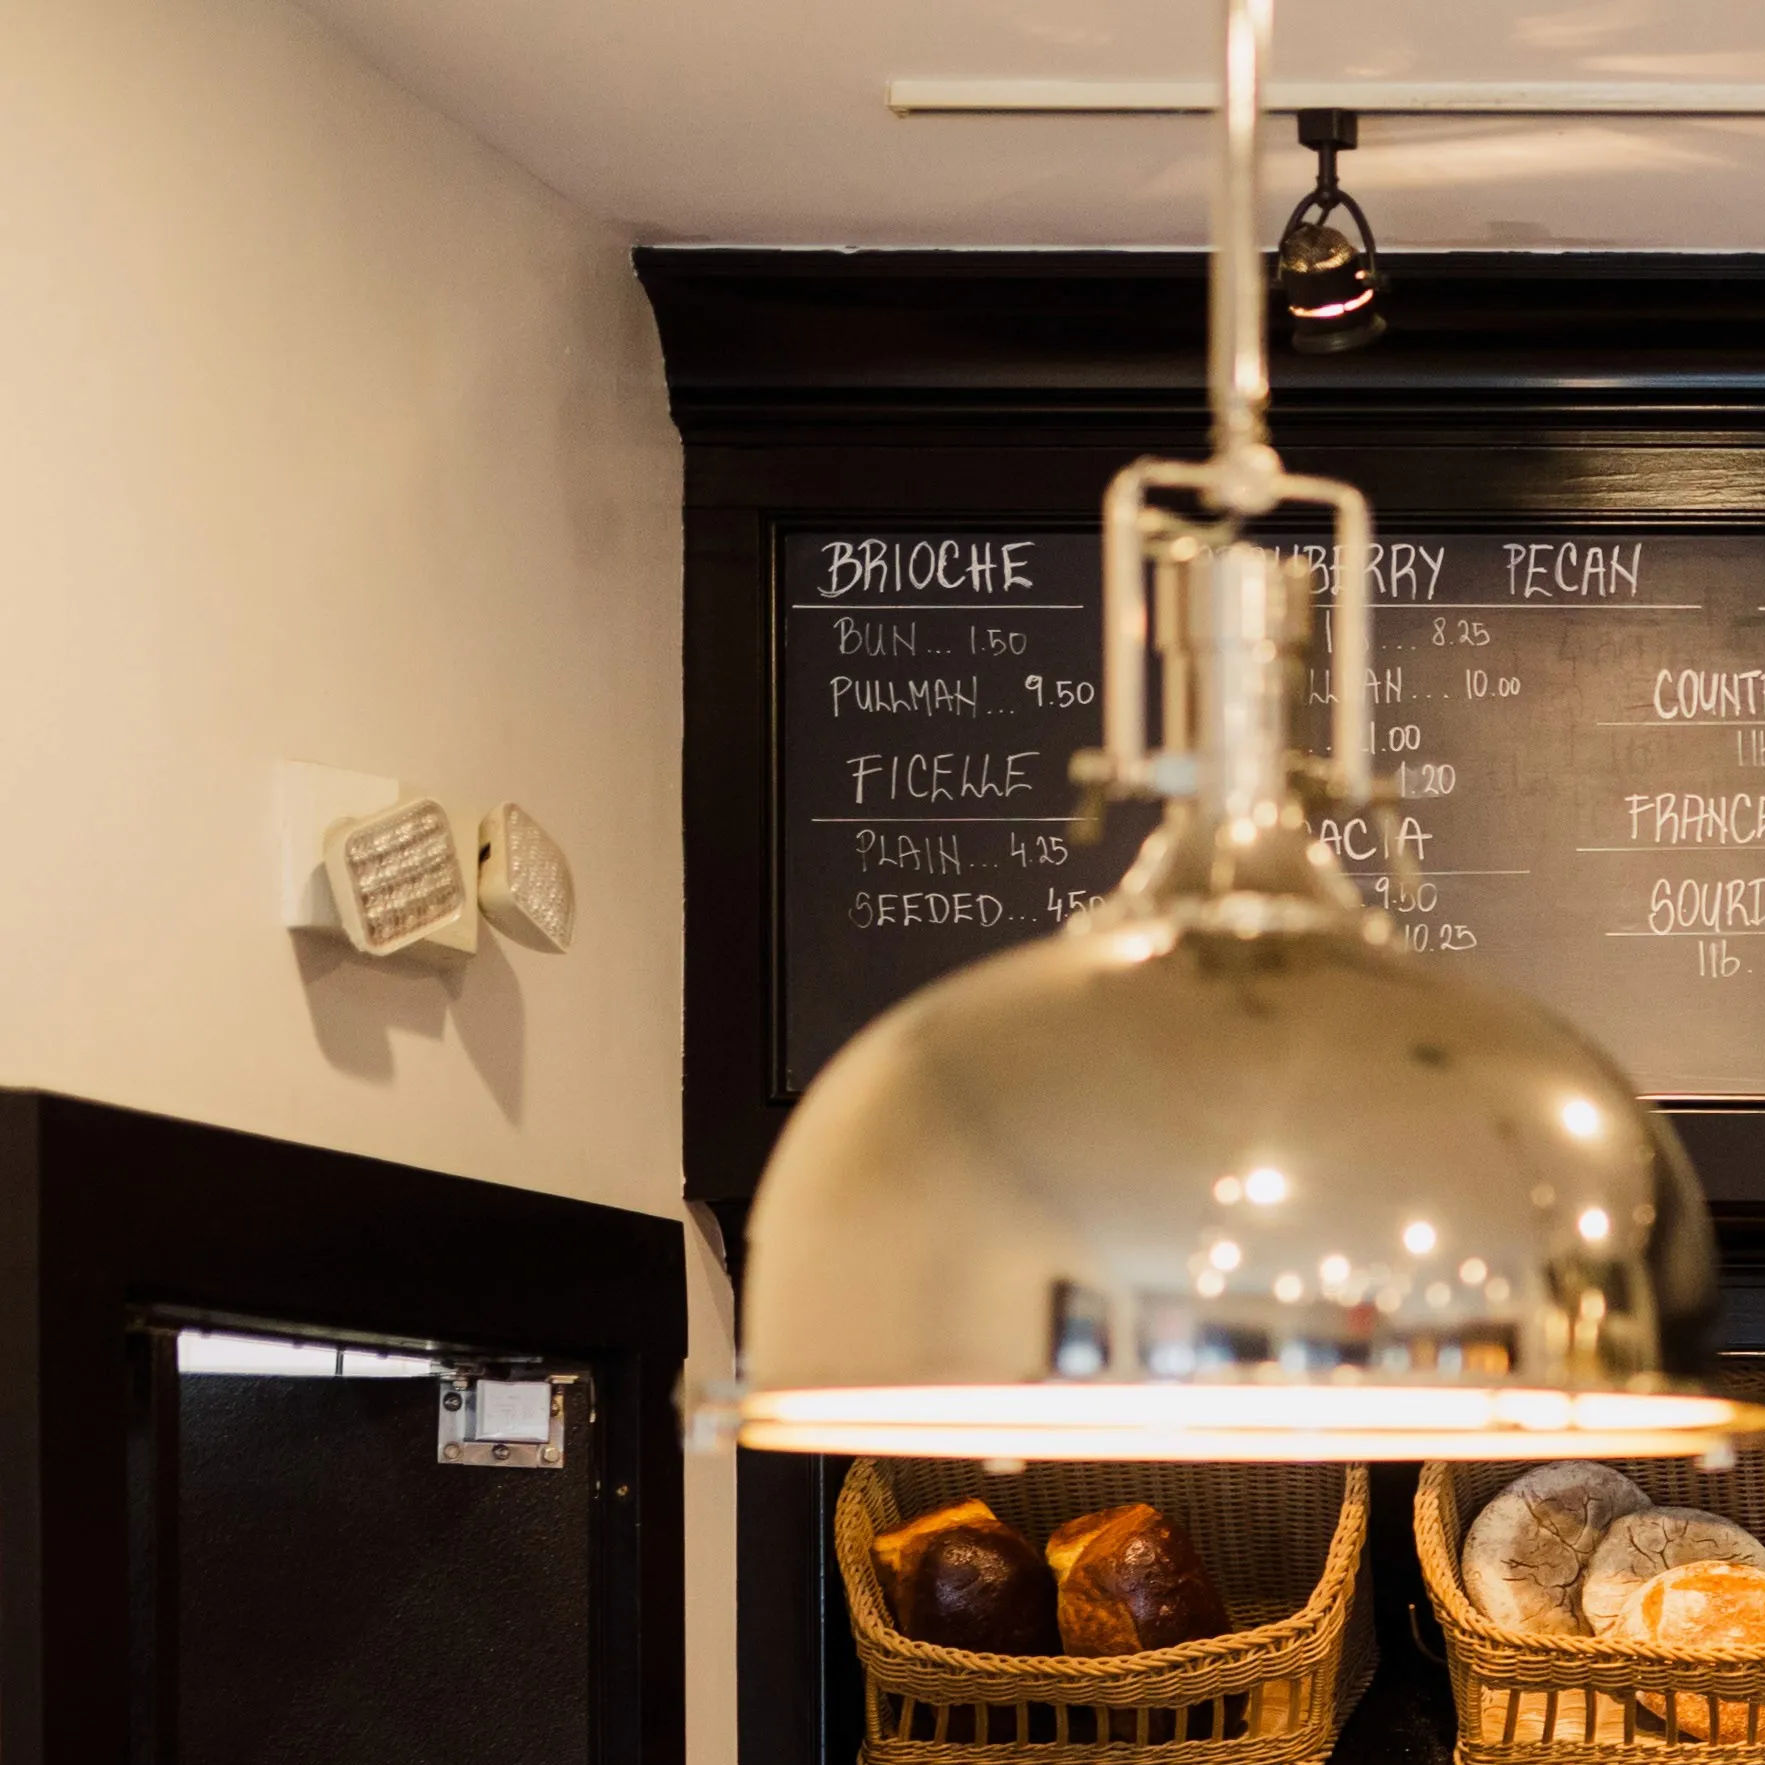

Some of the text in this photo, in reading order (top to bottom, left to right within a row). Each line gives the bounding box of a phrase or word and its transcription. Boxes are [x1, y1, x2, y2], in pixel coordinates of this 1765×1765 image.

[818, 541, 1035, 597] BRIOCHE
[1503, 543, 1642, 598] PECAN
[970, 627, 1027, 654] 1.50
[1432, 617, 1490, 646] 8.25
[1025, 674, 1094, 707] 9.50
[1466, 669, 1520, 697] 10.00
[847, 751, 1040, 802] FICELLE
[1009, 833, 1069, 866] 4.25
